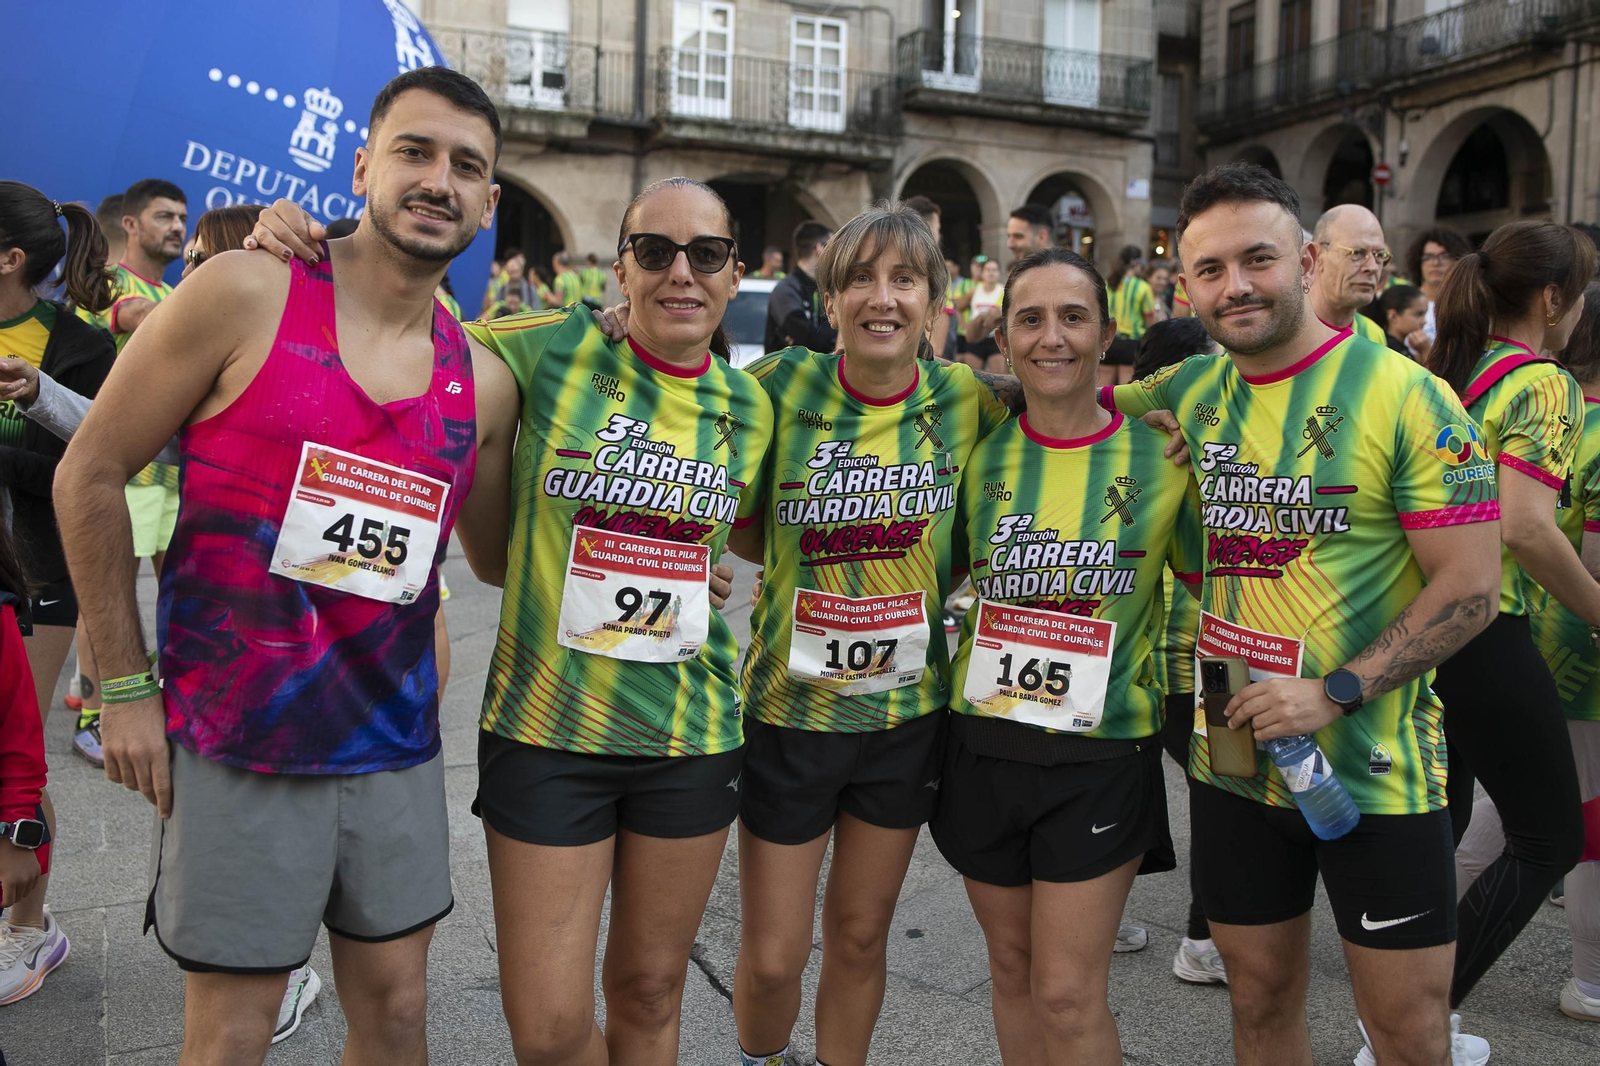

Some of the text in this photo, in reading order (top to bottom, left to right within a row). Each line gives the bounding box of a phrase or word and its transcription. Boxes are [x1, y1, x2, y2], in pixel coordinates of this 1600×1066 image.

[591, 373, 620, 389] RUN
[798, 409, 823, 422] RUN
[1194, 403, 1217, 416] RUN
[631, 440, 675, 455] EDICIÓN
[594, 445, 728, 491] CARRERA
[837, 455, 879, 468] EDICIÓN
[1221, 463, 1259, 475] EDICIÓN
[336, 461, 431, 497] III CARRERA DEL PILAR
[808, 461, 935, 496] CARRERA
[984, 482, 1005, 493] RUN
[1200, 475, 1313, 506] CARRERA
[322, 472, 436, 512] GUARDIA CIVIL DE OURENSE
[544, 468, 739, 524] GUARDIA CIVIL
[776, 484, 954, 525] GUARDIA CIVIL
[1275, 507, 1350, 535] CIVIL
[322, 513, 411, 566] 455
[800, 519, 929, 555] OURENSE
[1016, 529, 1059, 543] EDICIÓN
[591, 551, 704, 573] GUARDIA CIVIL DE OURENSE
[604, 540, 697, 559] III CARRERA DEL PILAR
[991, 540, 1116, 572] CARRERA
[328, 554, 396, 577] IVAN GOMEZ BLANCO
[1072, 569, 1136, 596] CIVIL
[615, 587, 671, 626] 97
[810, 608, 919, 624] GUARDIA CIVIL DE OURENSE
[835, 602, 871, 613] CARRERA
[872, 602, 886, 611] DEL
[887, 597, 909, 608] PILAR
[602, 623, 671, 638] SONIA PRADO PRIETO
[992, 622, 1104, 648] GUARDIA CIVIL DE OURENSE
[1002, 613, 1095, 634] III CARRERA DEL PILAR
[1203, 633, 1293, 666] GUARDIA CIVIL DE OURENSE
[1216, 626, 1240, 641] CARRERA
[1241, 636, 1255, 646] DEL
[1256, 640, 1283, 651] PILAR
[825, 639, 898, 671] 107
[820, 670, 844, 680] MONTSE
[845, 673, 867, 681] CASTRO
[996, 653, 1071, 696] 165
[999, 689, 1017, 699] PAULA
[1039, 696, 1062, 706] GOMEZ
